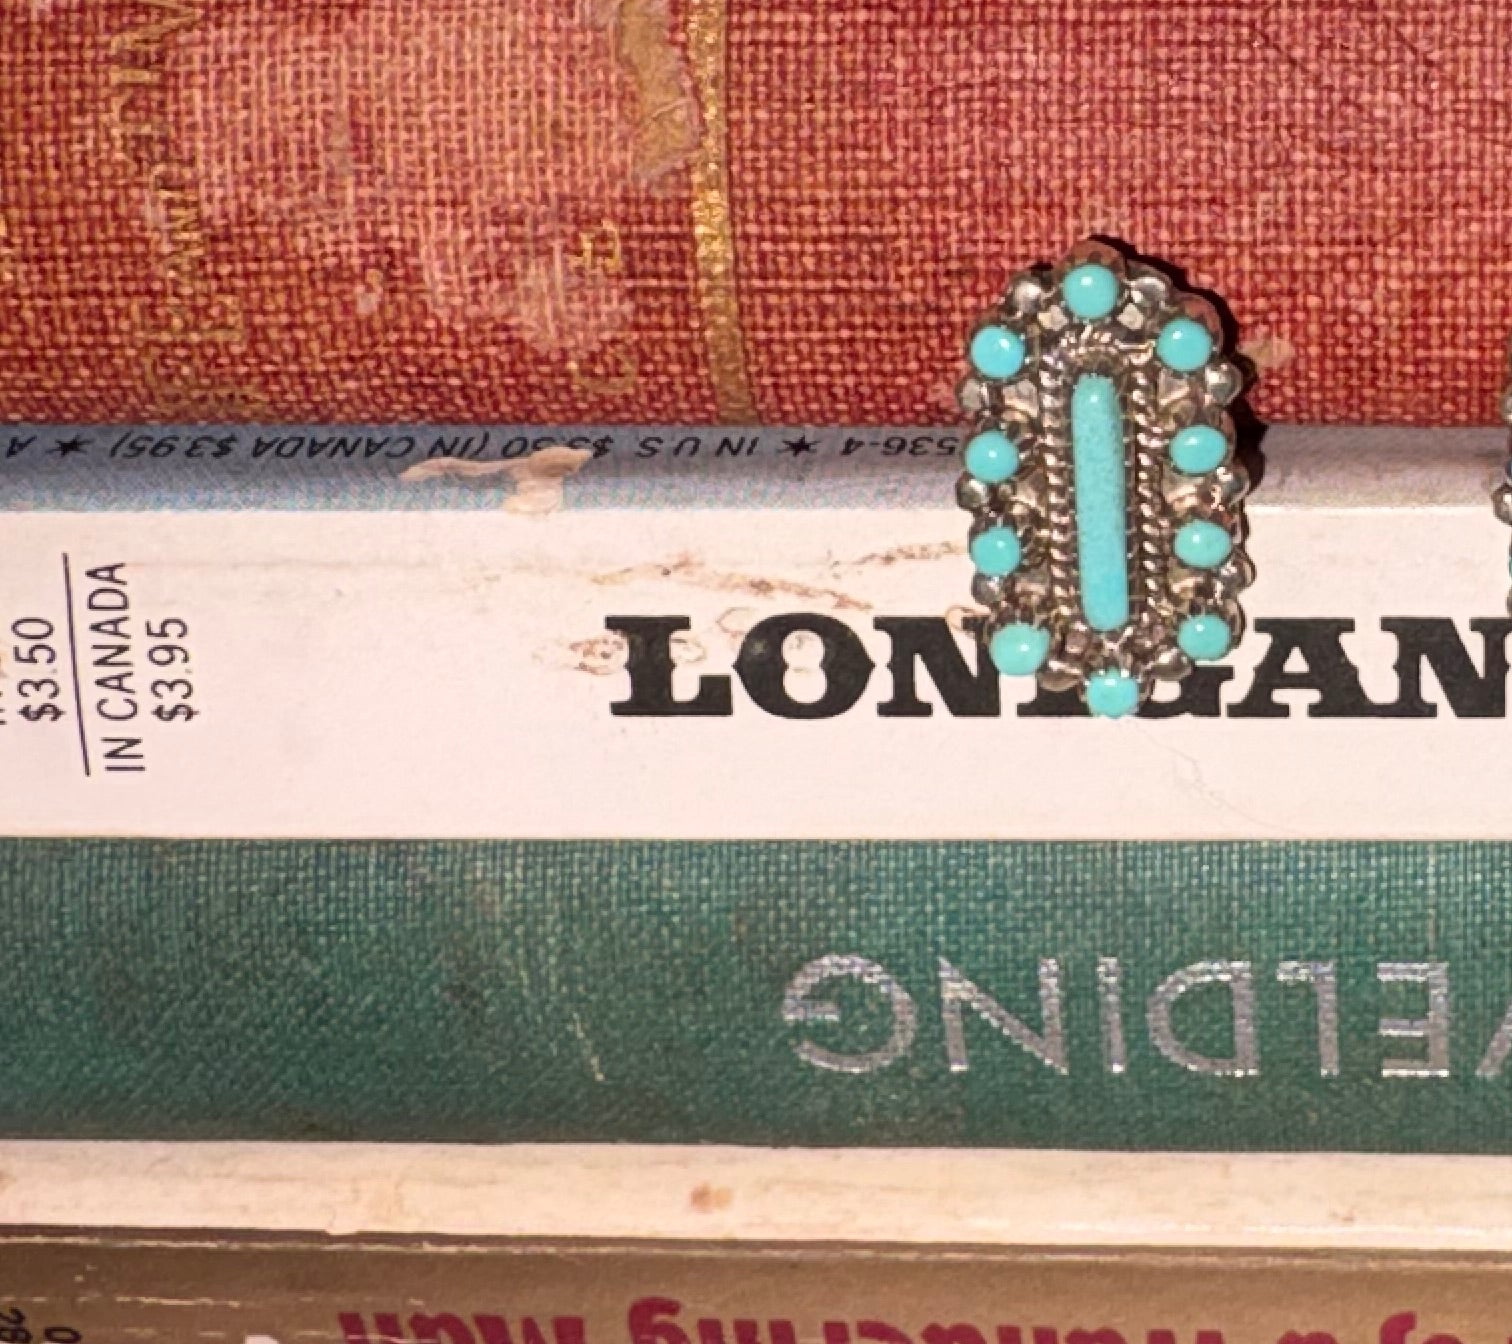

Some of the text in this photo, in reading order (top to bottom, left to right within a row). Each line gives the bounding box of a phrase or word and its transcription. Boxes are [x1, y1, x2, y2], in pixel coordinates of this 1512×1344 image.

[109, 432, 239, 459] $3.95)
[251, 435, 414, 458] CANADA
[428, 432, 491, 459] (IN
[714, 435, 760, 457] IN
[11, 616, 65, 723] $3.50
[85, 561, 147, 773] IN CANADA
[146, 616, 200, 723] $3.95
